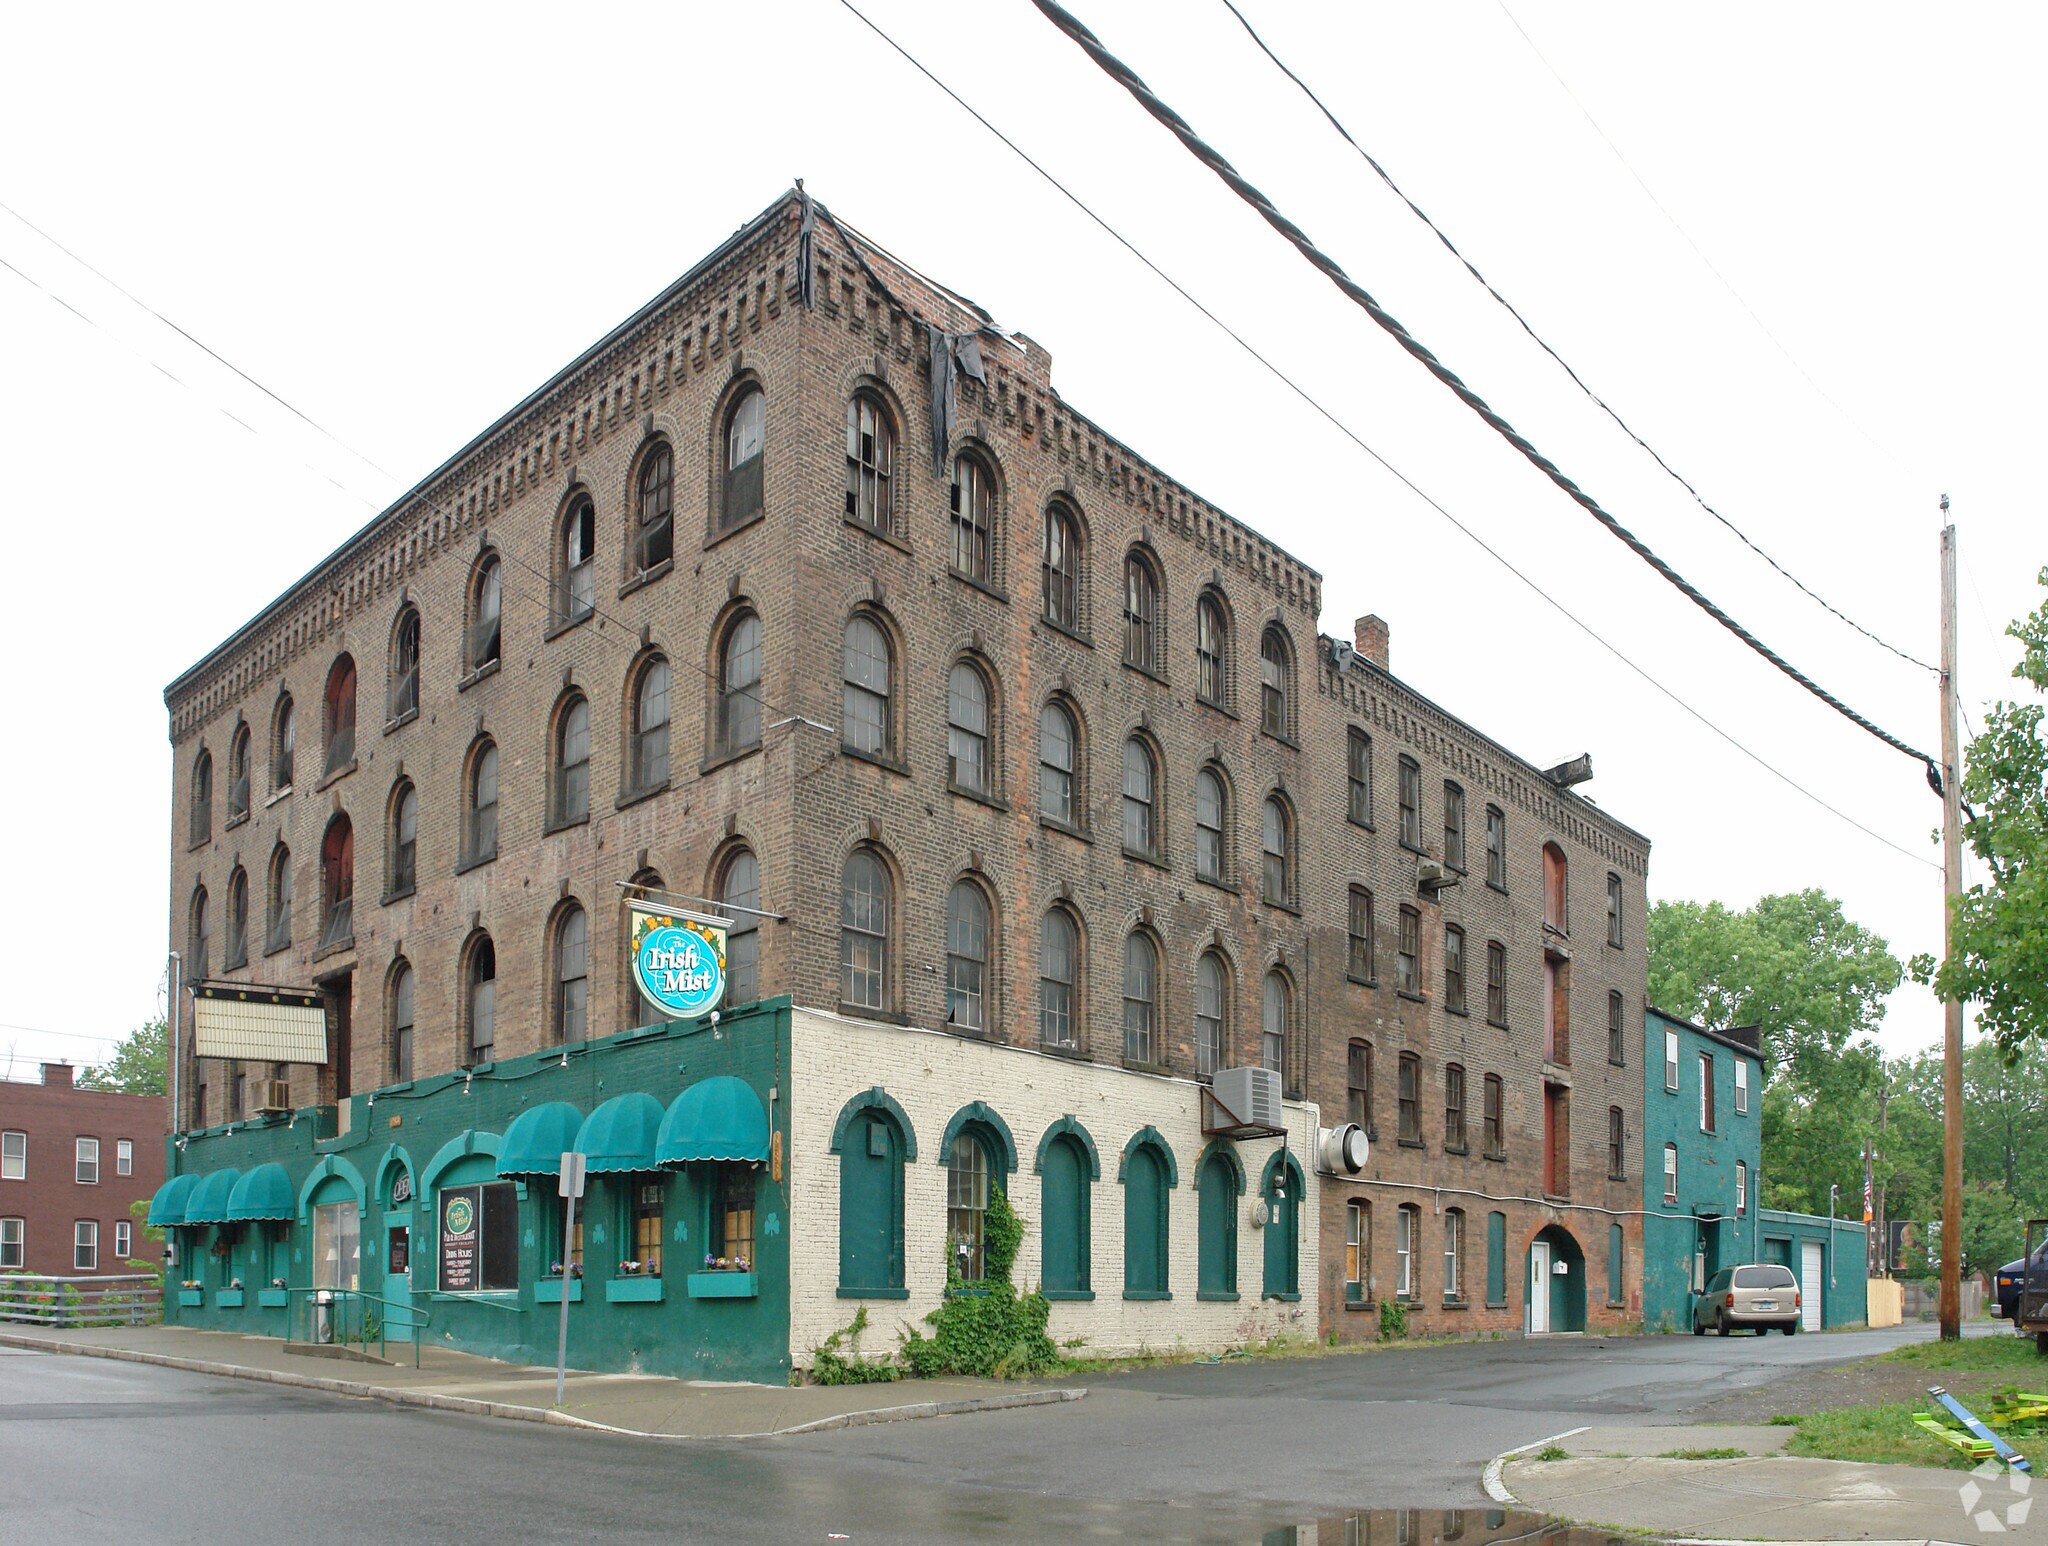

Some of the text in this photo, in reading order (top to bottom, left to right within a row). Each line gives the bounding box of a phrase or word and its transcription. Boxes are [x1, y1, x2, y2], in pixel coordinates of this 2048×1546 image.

[673, 940, 686, 948] The
[648, 944, 700, 970] Irish
[662, 968, 712, 992] Mist
